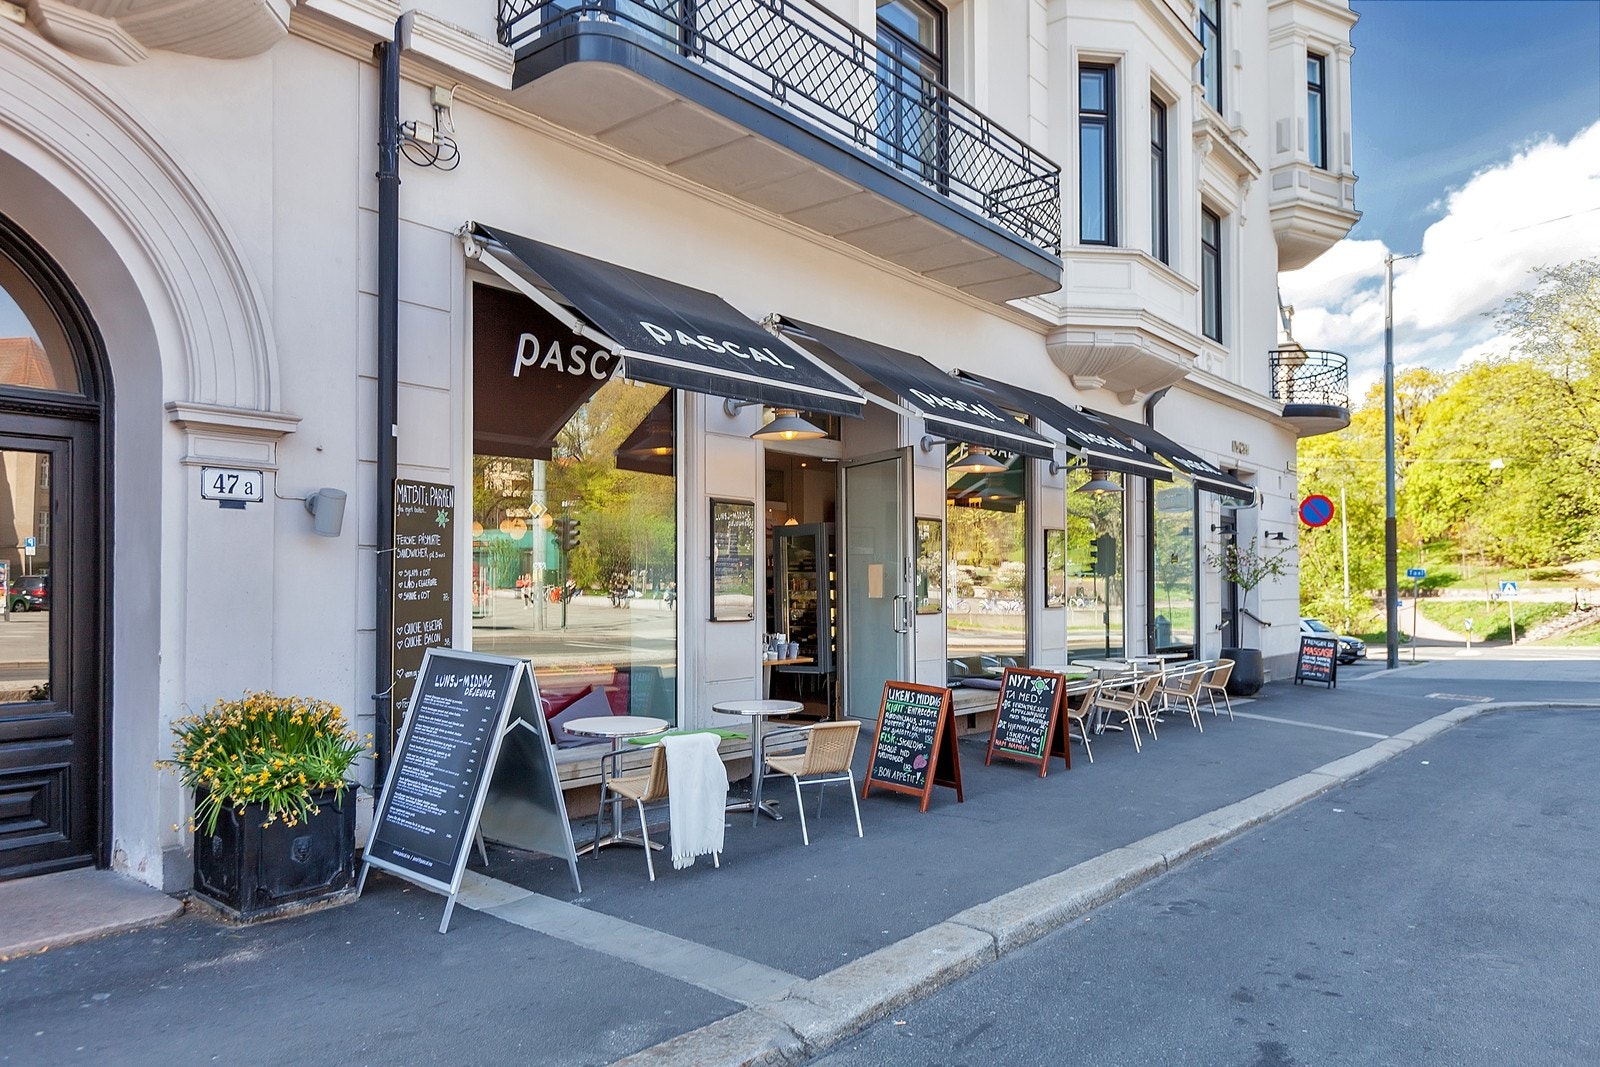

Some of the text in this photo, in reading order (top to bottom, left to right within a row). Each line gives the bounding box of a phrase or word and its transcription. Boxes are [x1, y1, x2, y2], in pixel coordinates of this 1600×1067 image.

[640, 321, 795, 370] PASCAL
[909, 388, 1005, 422] PASCAL
[1067, 428, 1134, 453] PASCAL
[213, 474, 253, 495] 47 a
[397, 484, 425, 506] MATBIT
[430, 487, 455, 509] PARKEN
[421, 591, 430, 600] OST
[404, 622, 422, 635] QUICHE
[404, 635, 422, 648] QUICHE
[435, 674, 493, 688] LUNSJ-MIDDAG
[1009, 674, 1032, 689] NYT
[888, 689, 942, 707] UKENS MIDDAG
[1006, 690, 1042, 704] TA MED:
[1007, 731, 1031, 742] ISKREM
[878, 767, 891, 777] BON
